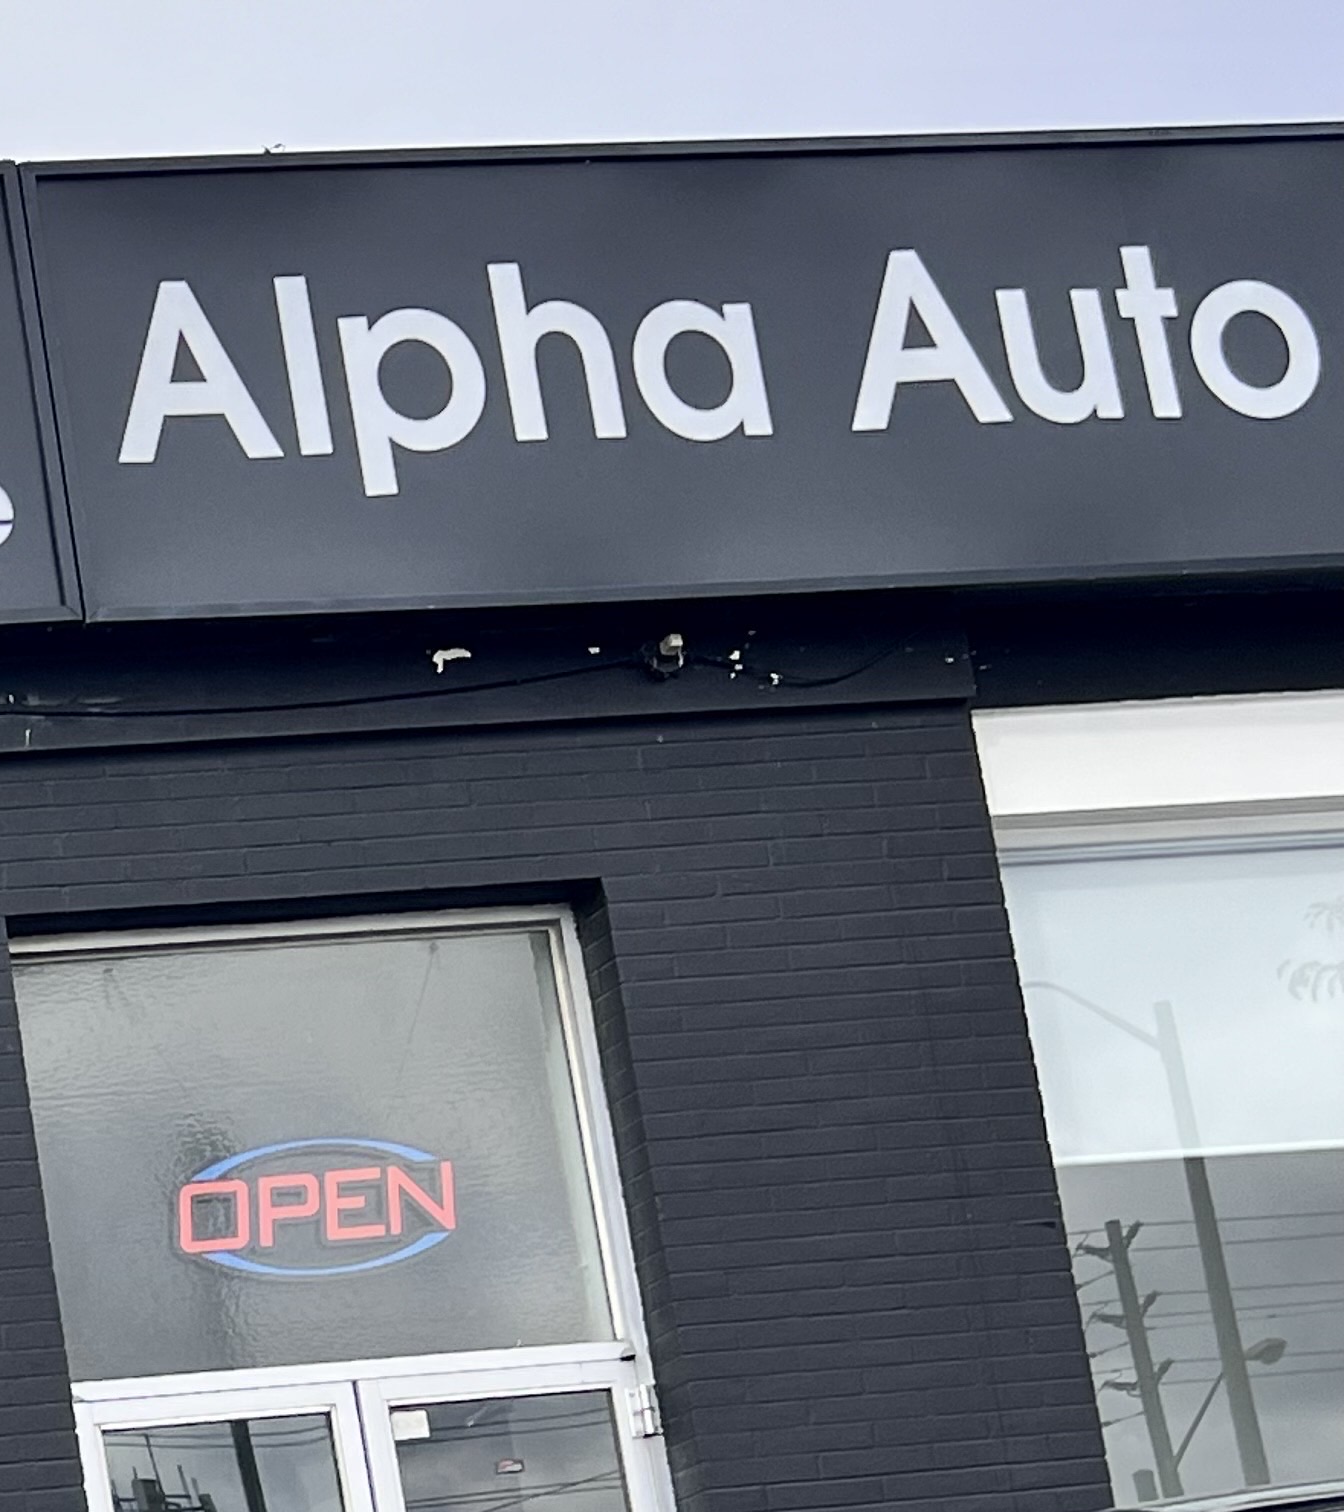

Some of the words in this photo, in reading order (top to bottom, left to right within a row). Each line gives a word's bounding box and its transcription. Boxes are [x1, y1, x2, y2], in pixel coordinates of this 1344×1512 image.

[118, 262, 775, 498] Alpha
[851, 245, 1321, 432] Auto
[178, 1160, 457, 1255] OPEN
